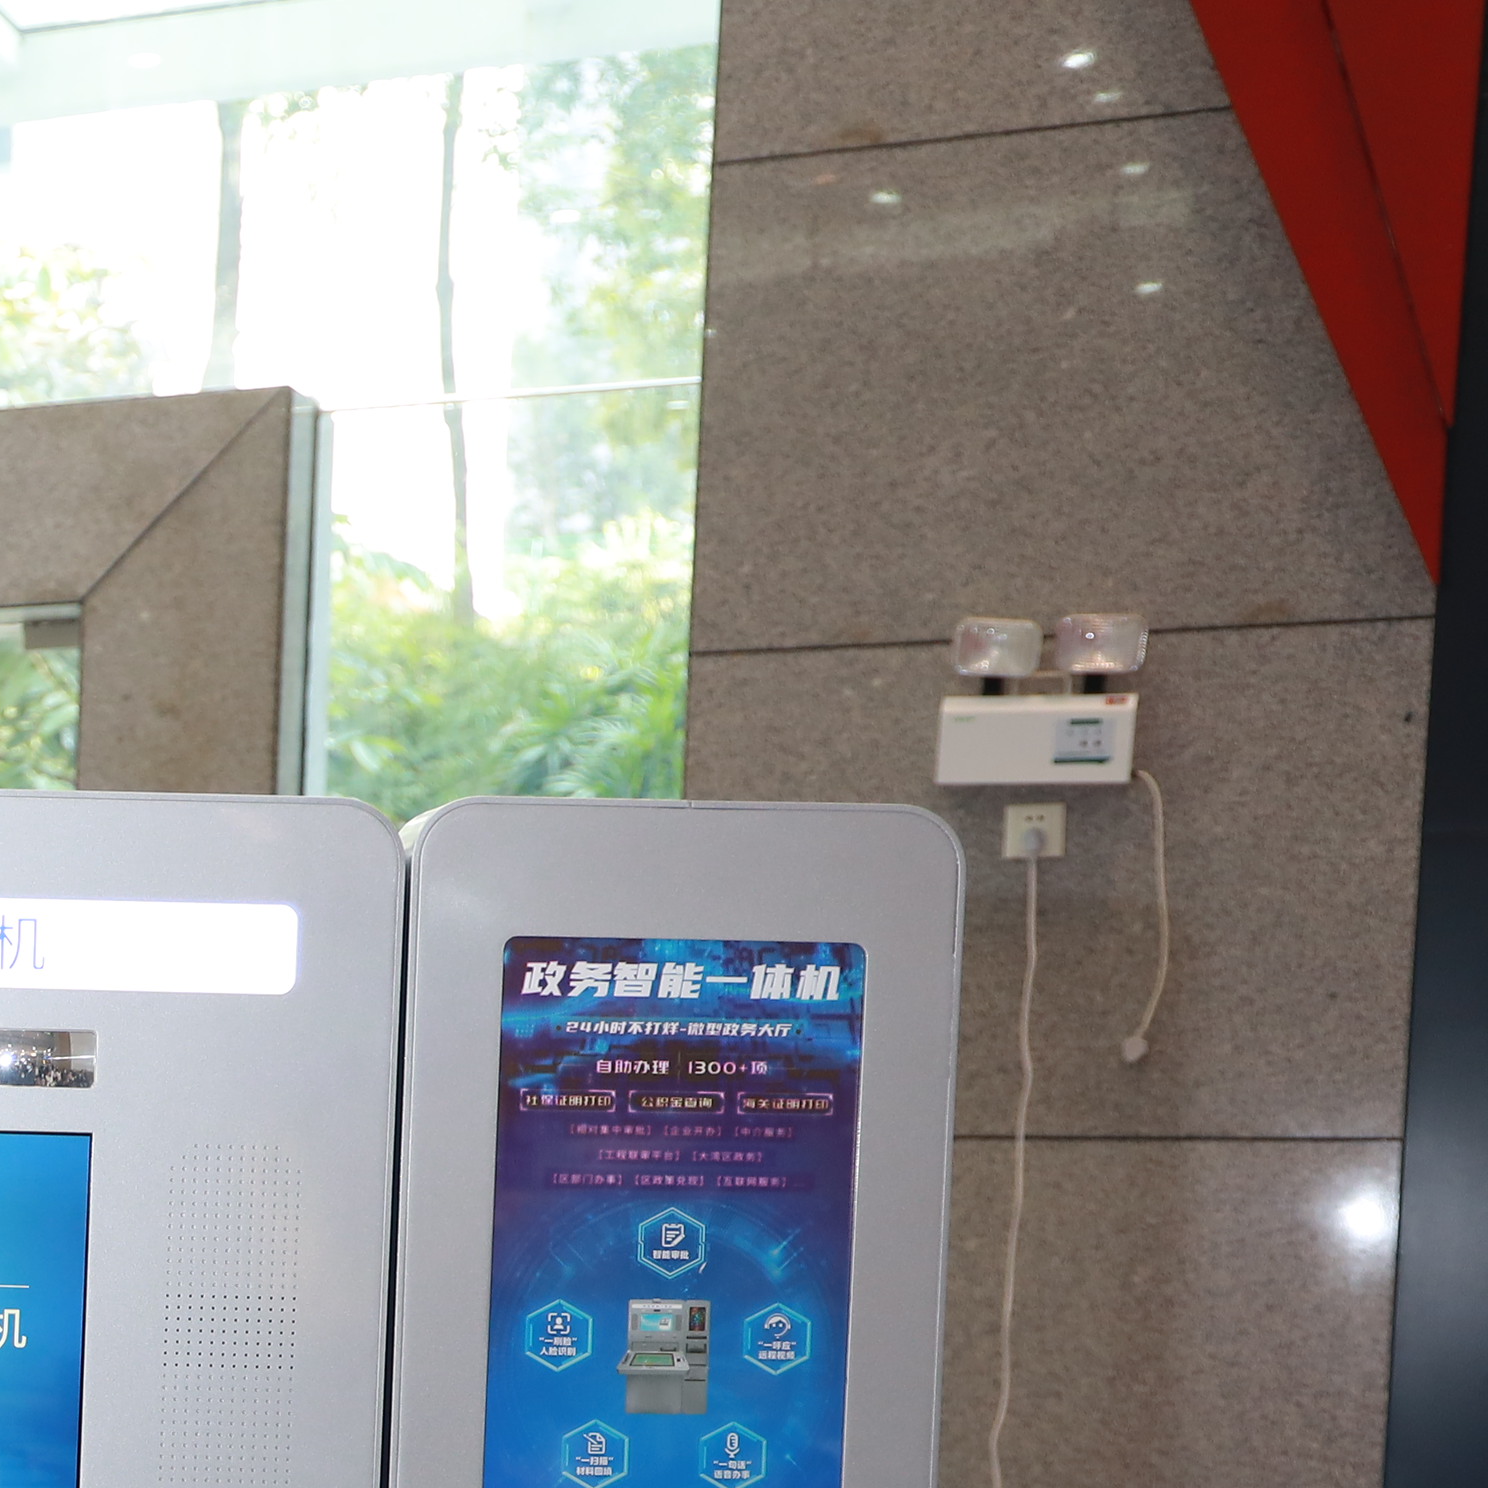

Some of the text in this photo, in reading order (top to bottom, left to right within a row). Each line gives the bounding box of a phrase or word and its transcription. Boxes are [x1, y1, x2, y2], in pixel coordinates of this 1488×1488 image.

[521, 961, 841, 1000] 政务智能一体机
[596, 1060, 768, 1076] 自助办理 1300+项
